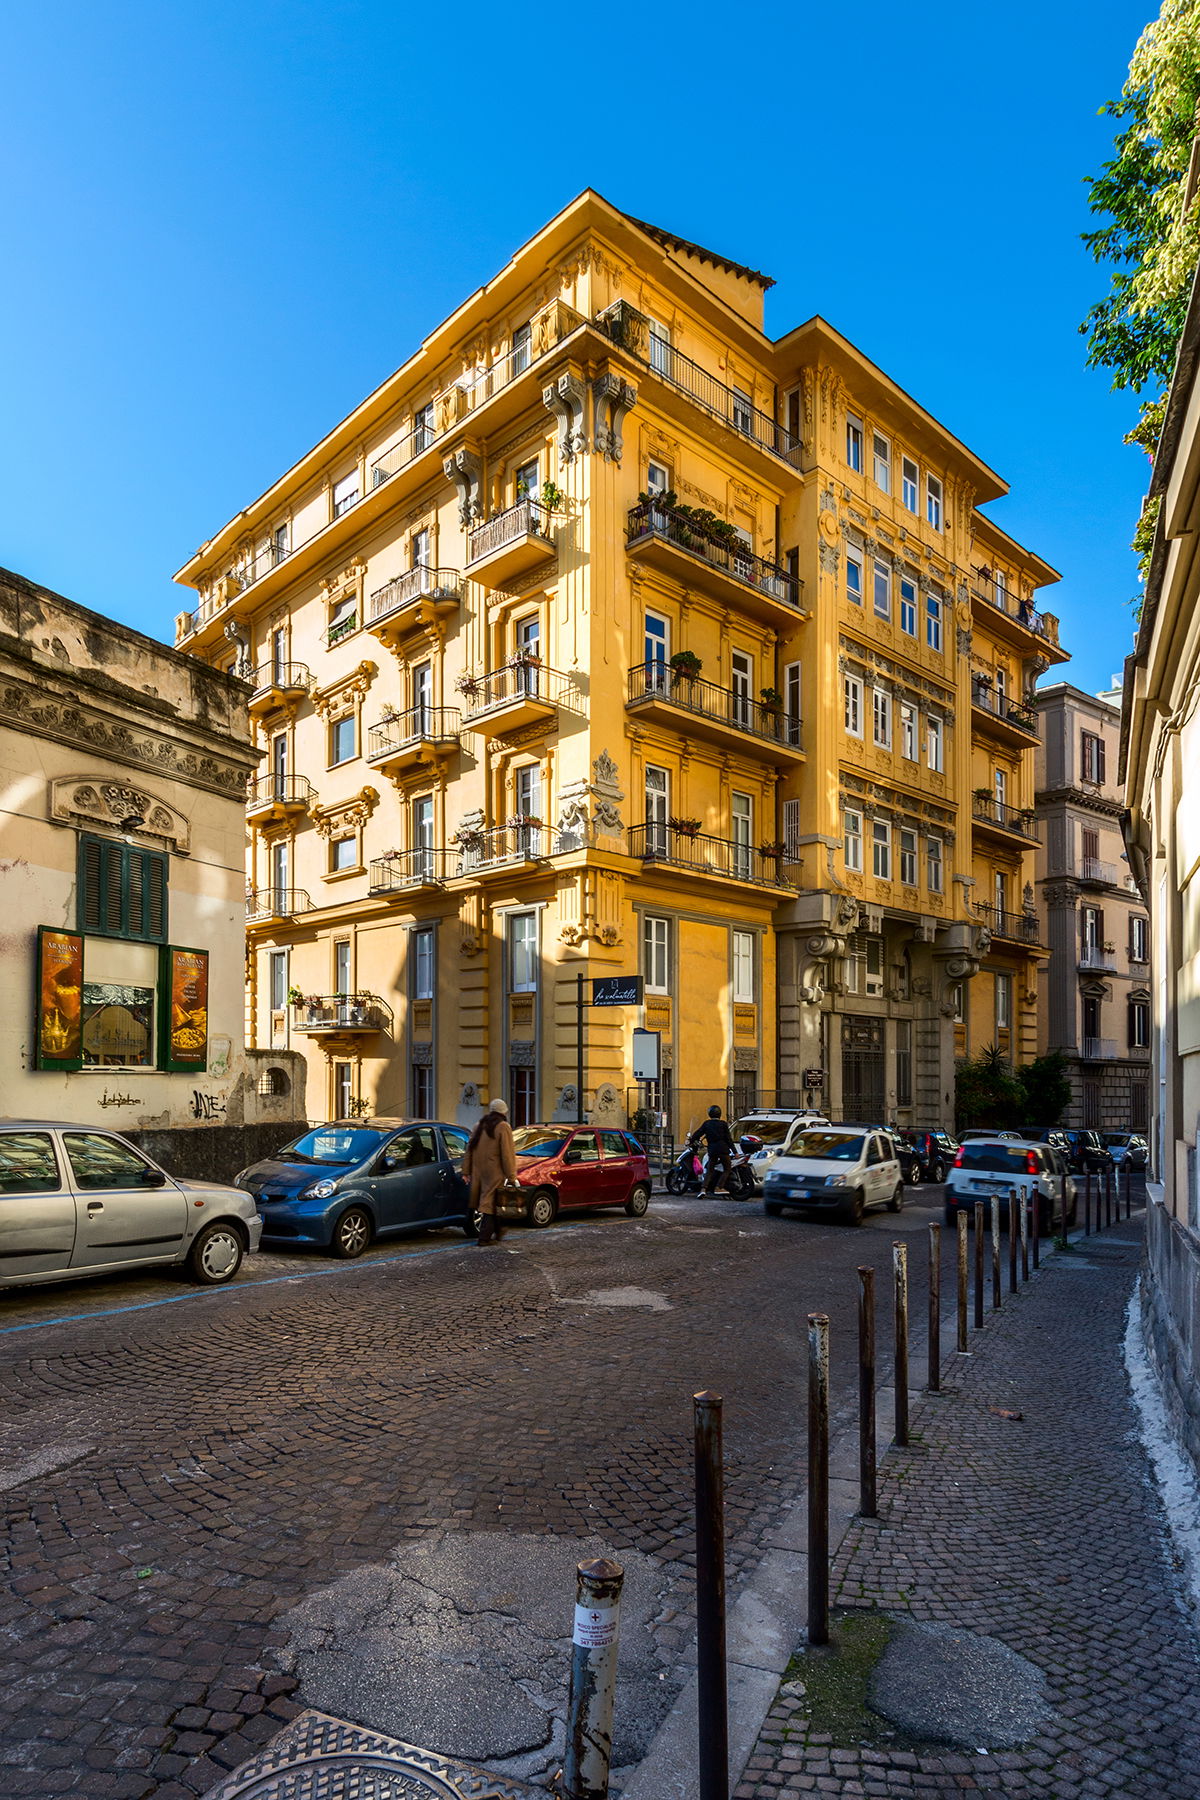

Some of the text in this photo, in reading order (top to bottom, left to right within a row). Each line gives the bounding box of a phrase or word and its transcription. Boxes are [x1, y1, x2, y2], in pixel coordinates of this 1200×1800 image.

[47, 942, 78, 953] ARABIAN
[177, 956, 205, 967] ARABIAN
[360, 1768, 433, 1800] FOGNATURA
